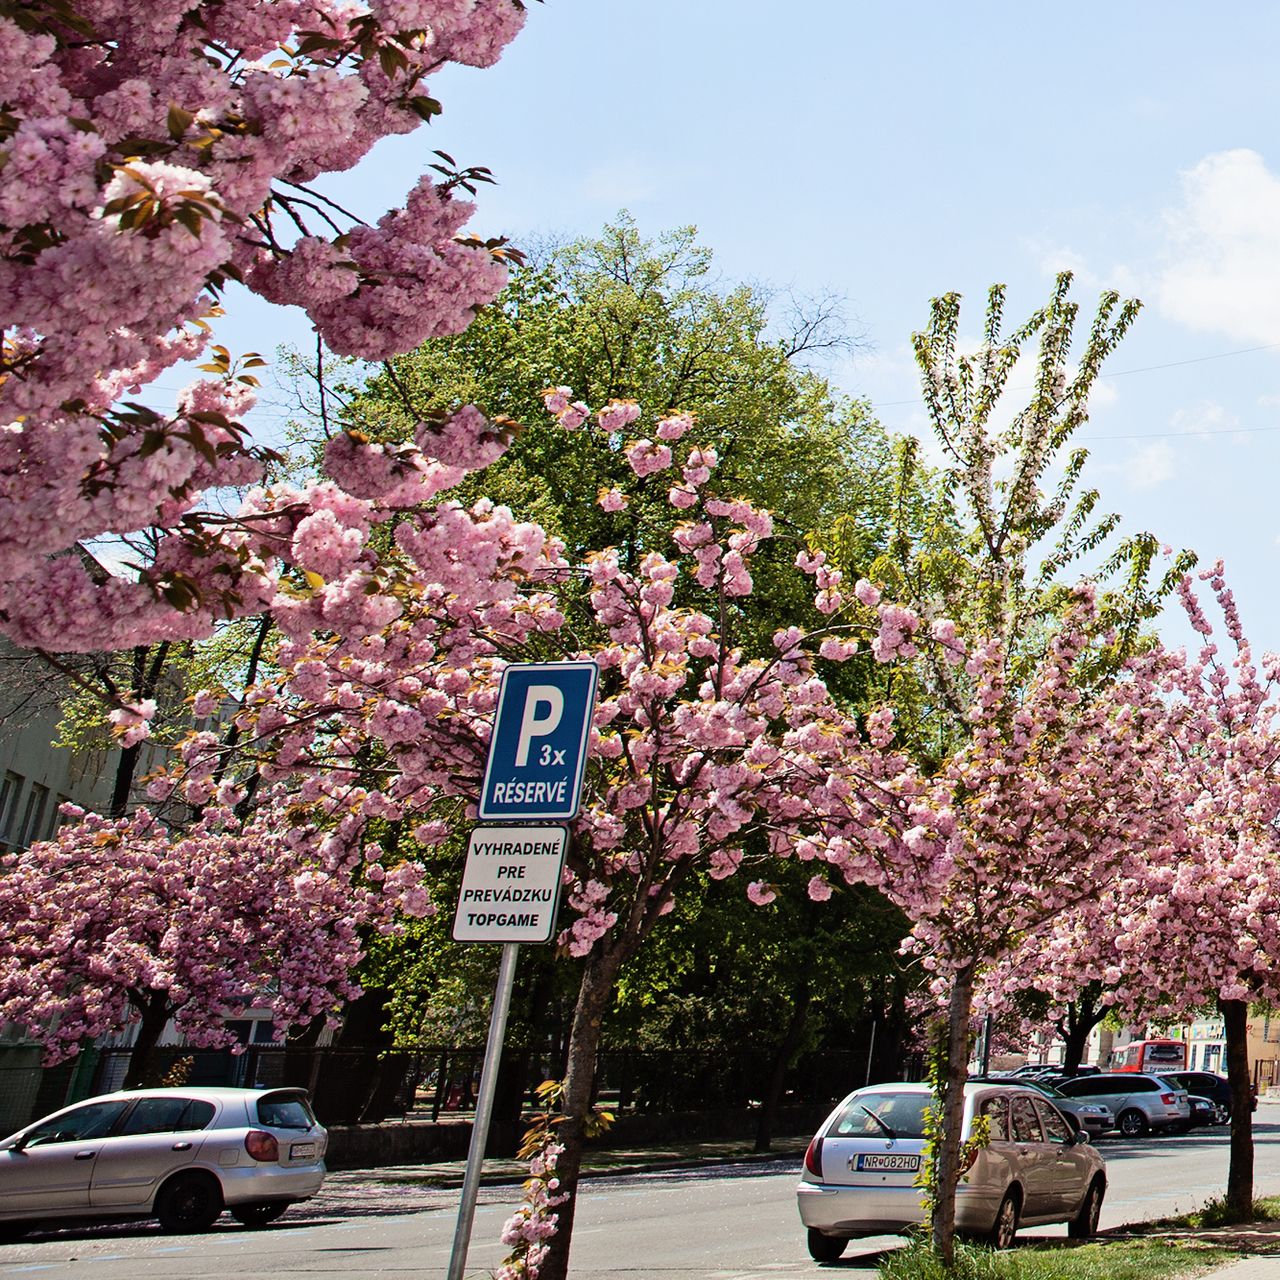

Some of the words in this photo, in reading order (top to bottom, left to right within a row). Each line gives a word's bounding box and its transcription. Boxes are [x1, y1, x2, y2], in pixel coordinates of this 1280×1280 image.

[515, 685, 564, 767] P
[539, 744, 566, 766] 3x
[493, 776, 567, 804] RÉSERVÉ
[473, 838, 560, 856] VYHRADENÉ
[497, 866, 526, 879] PRE
[463, 885, 552, 902] PREVÁDZKU
[467, 914, 539, 926] TOPGAME
[864, 1156, 878, 1168] NR
